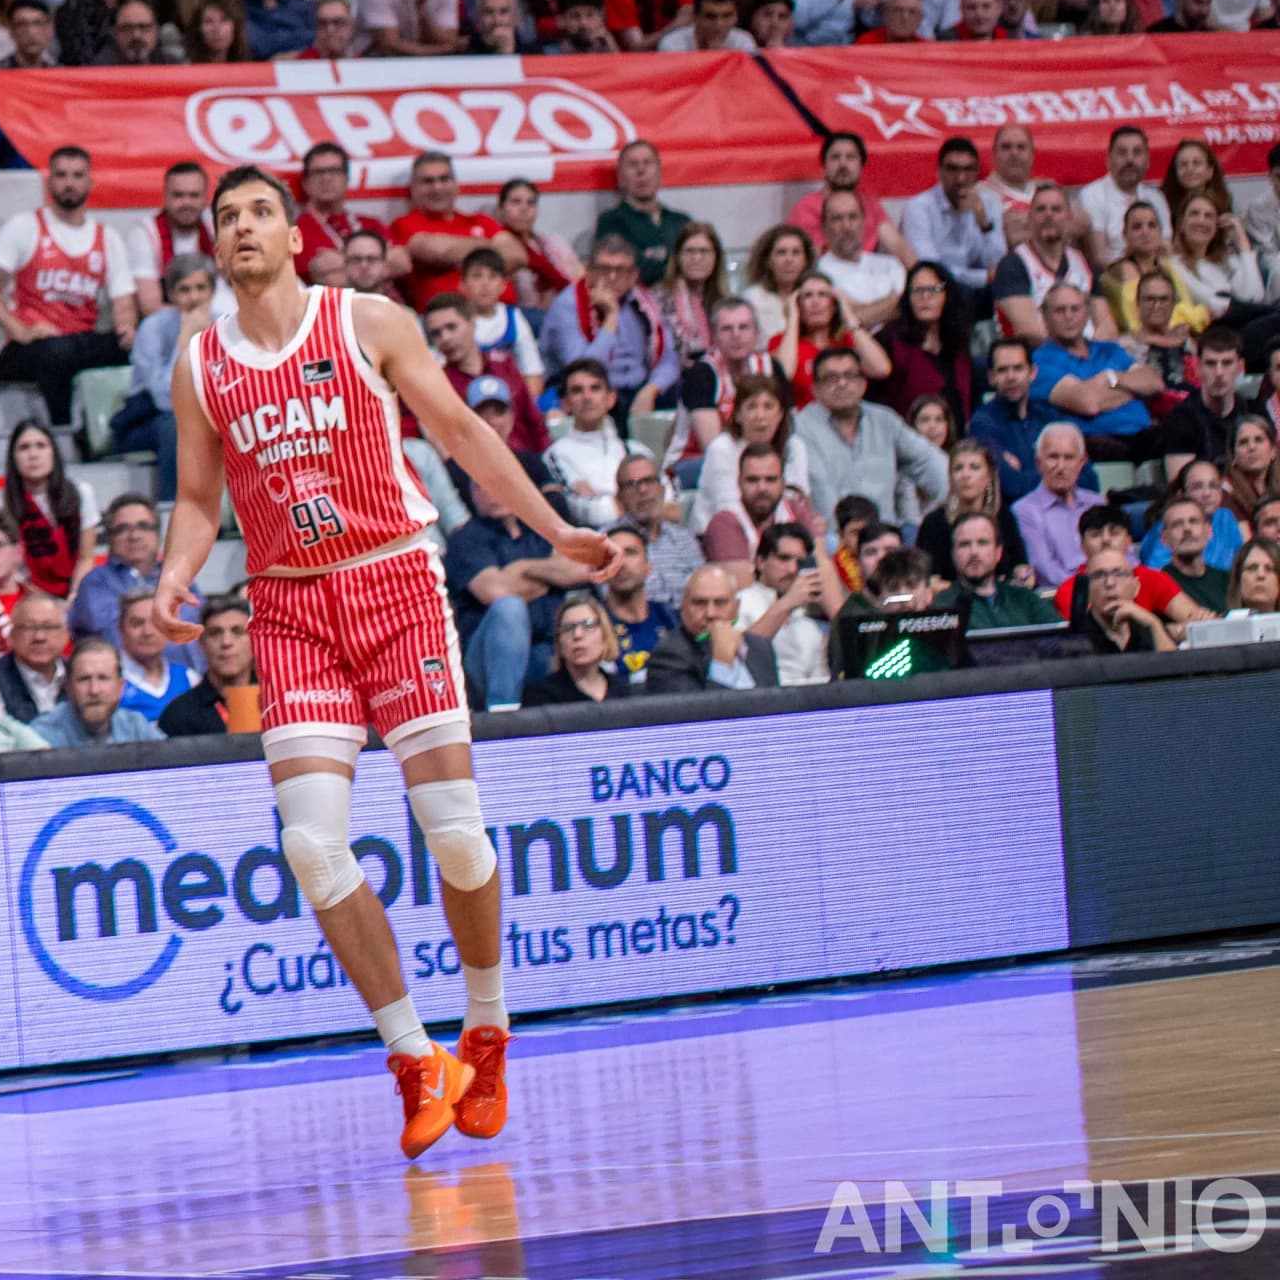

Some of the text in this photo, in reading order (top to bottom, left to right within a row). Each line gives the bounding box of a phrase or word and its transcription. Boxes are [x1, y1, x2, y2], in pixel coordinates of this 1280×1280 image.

[931, 81, 1206, 127] ESTRELLA
[229, 396, 348, 454] UCAM
[255, 436, 333, 470] MURCIA
[290, 494, 346, 548] 99
[284, 687, 353, 704] INVERSUS
[589, 753, 733, 803] BANCO
[50, 802, 738, 943] medolnum
[415, 941, 463, 976] so
[510, 922, 574, 969] tus
[588, 893, 741, 960] metas?
